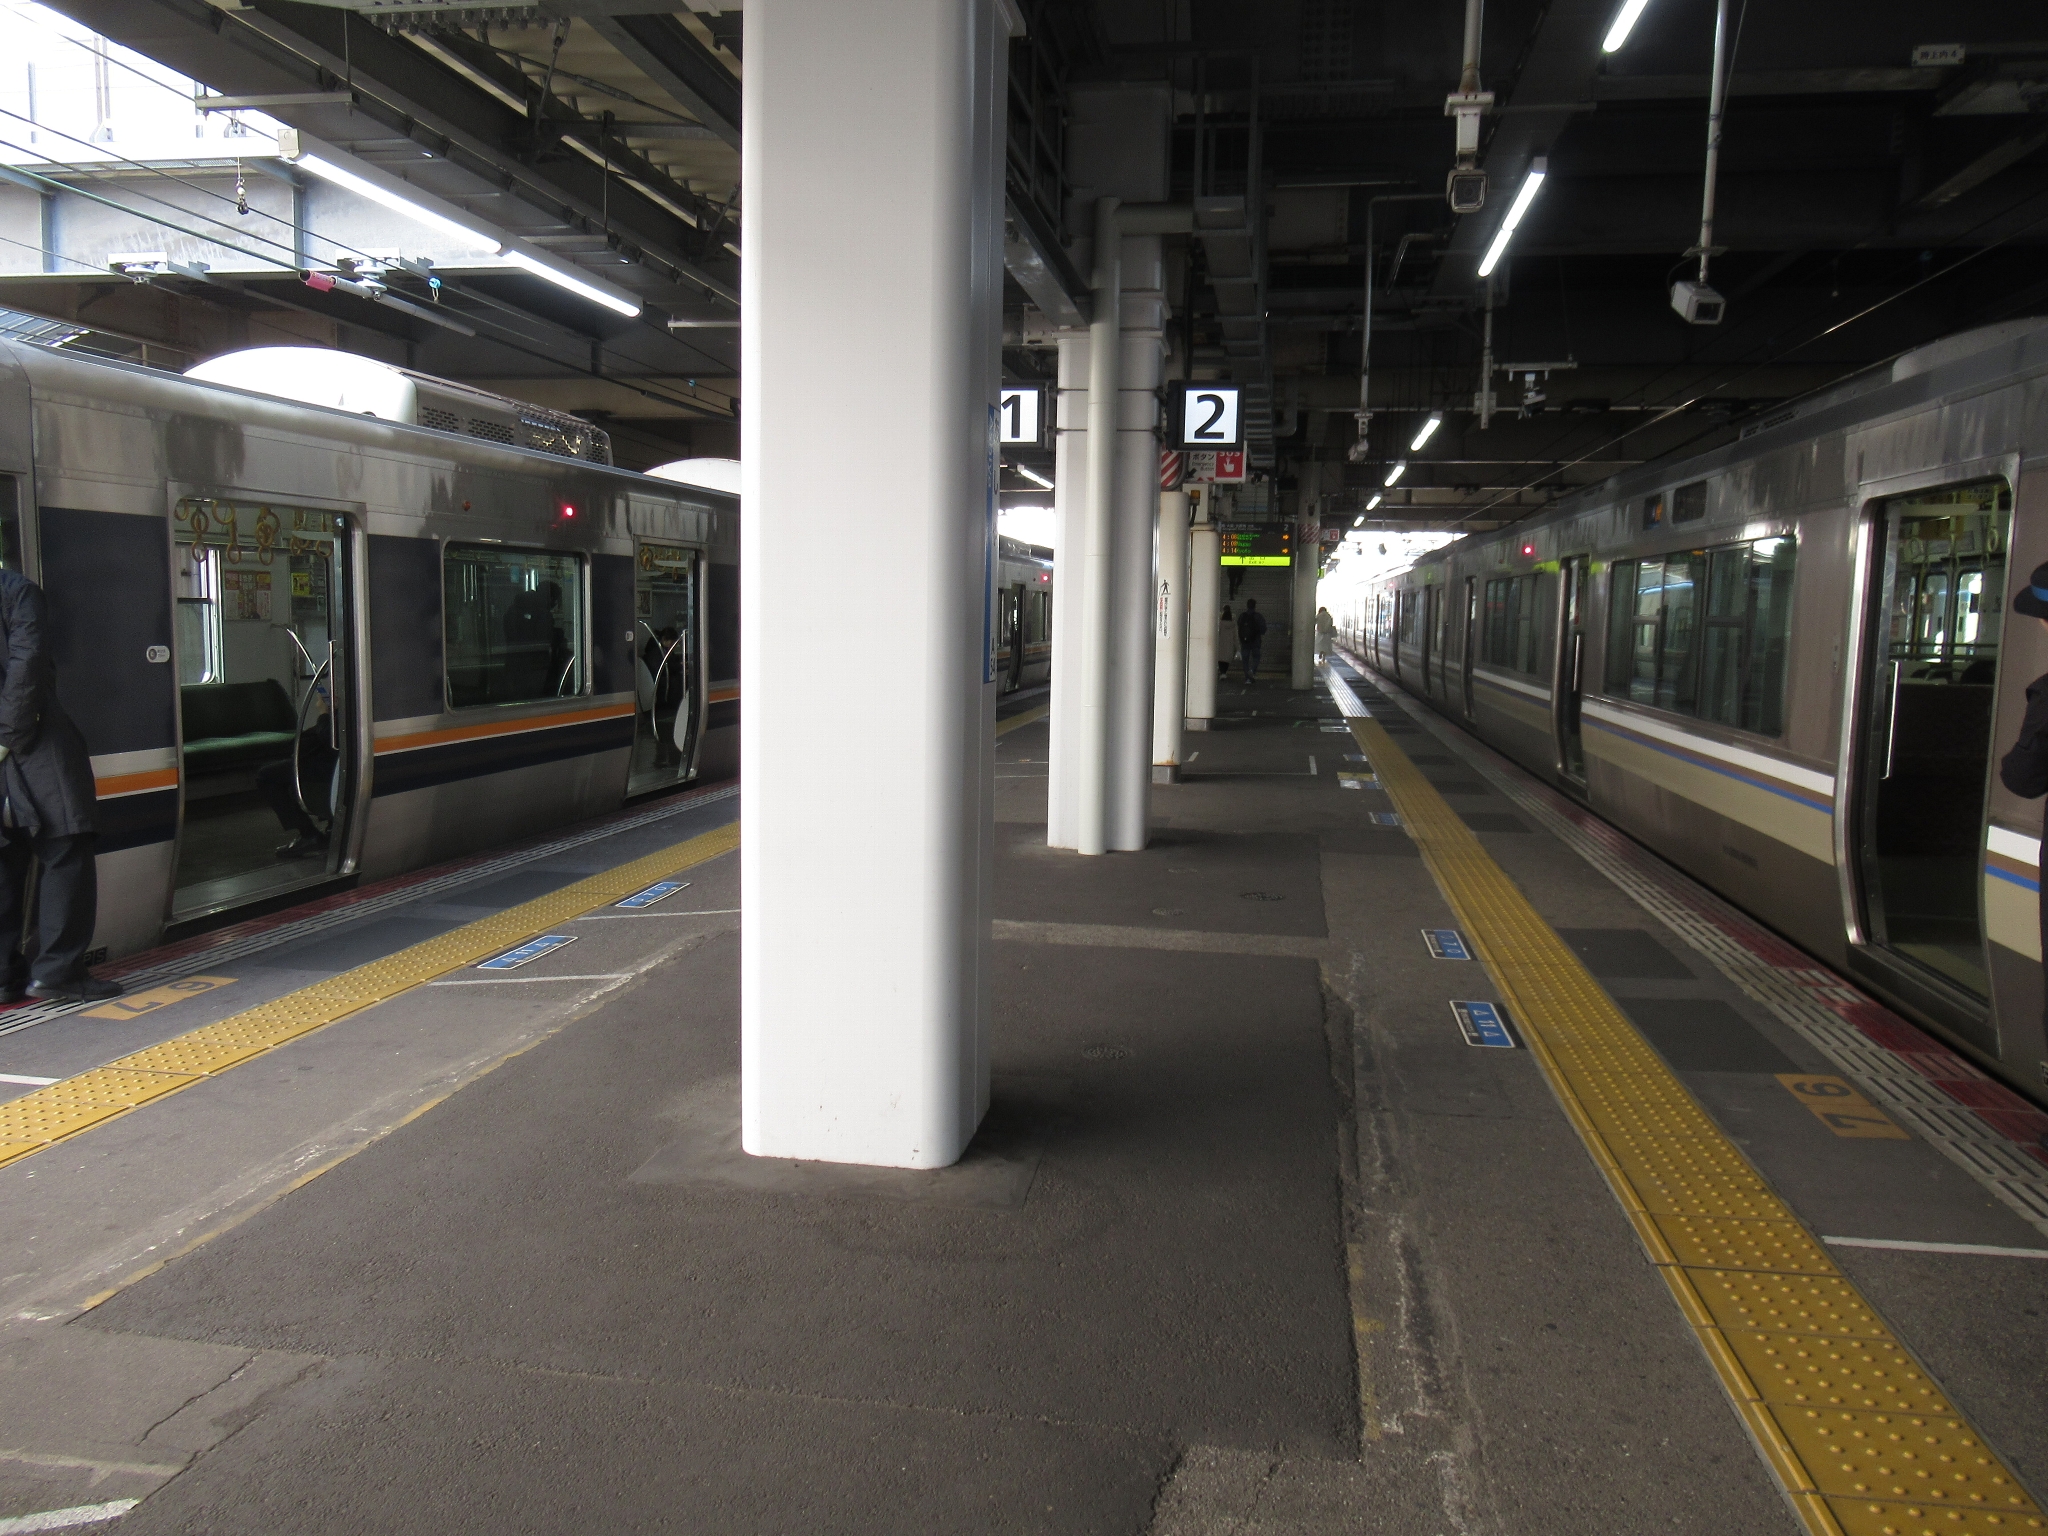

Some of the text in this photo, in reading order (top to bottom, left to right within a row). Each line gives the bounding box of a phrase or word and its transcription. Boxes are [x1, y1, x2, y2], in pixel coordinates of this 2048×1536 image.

[1001, 395, 1021, 438] 1
[1194, 394, 1225, 440] 2
[1192, 453, 1215, 461] ボタン
